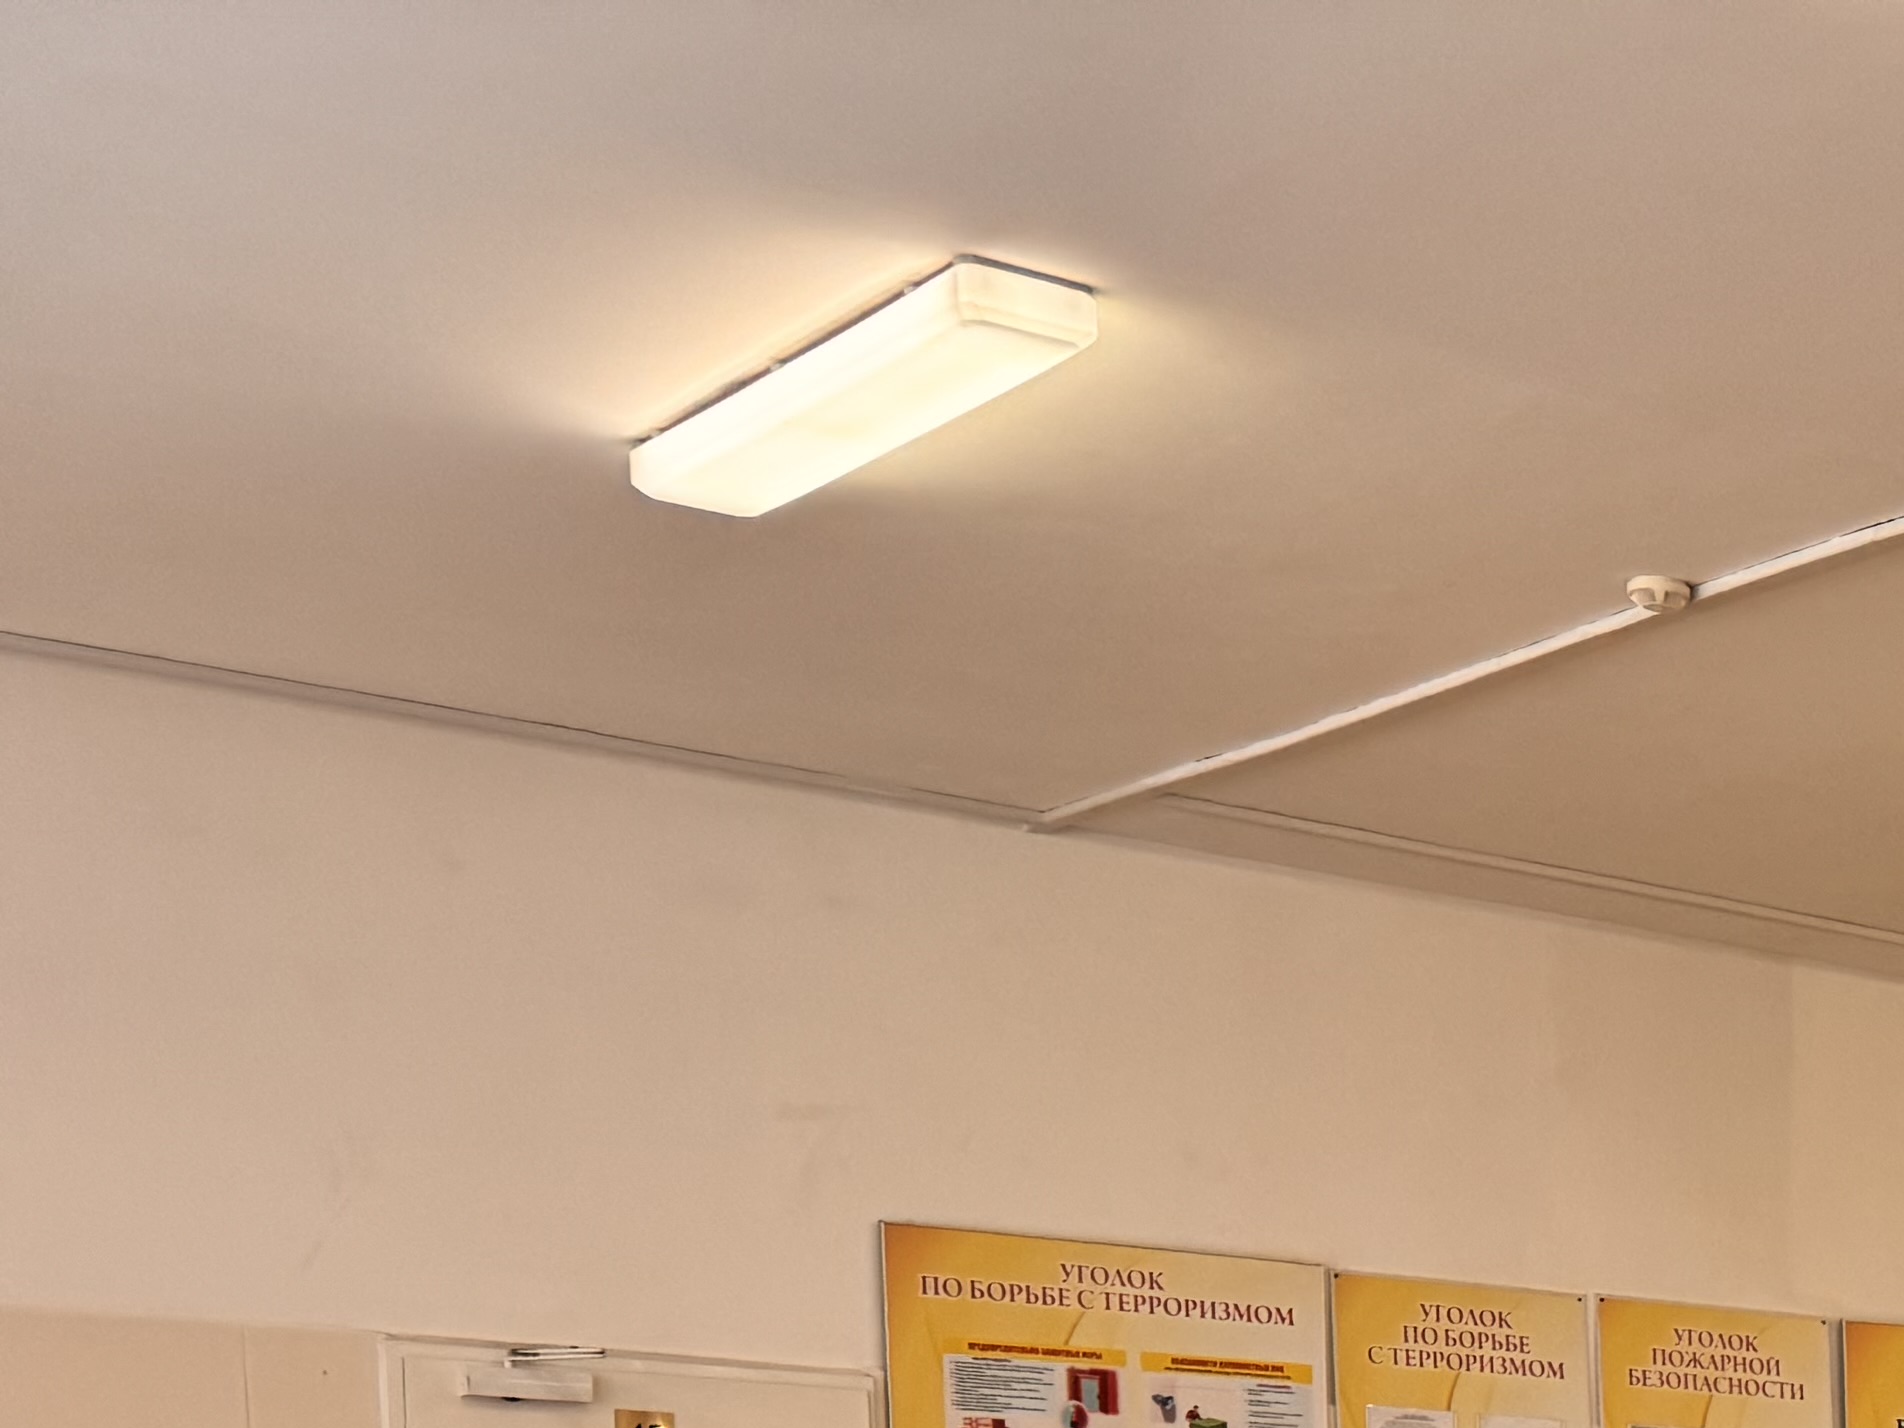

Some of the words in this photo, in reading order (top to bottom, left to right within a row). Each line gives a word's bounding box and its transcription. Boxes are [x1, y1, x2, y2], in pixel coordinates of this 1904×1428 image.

[1060, 1263, 1164, 1292] УГОЛОК
[921, 1275, 962, 1298] ПО
[970, 1279, 1071, 1308] БОРЬБЕ
[1078, 1290, 1095, 1310] С
[1100, 1291, 1295, 1326] ТЕРРОРИЗМОМ
[1420, 1303, 1512, 1329] УГОЛОК
[1403, 1324, 1440, 1346] ПО
[1444, 1330, 1530, 1355] БОРЬБЕ
[1673, 1328, 1758, 1352] УГОЛОК
[1368, 1345, 1384, 1364] С
[1387, 1347, 1565, 1380] ТЕРРОРИЗМОМ
[1651, 1347, 1781, 1376] ПОЖАРНОЙ
[1628, 1368, 1805, 1400] БЕЗОПАСНОСТИ
